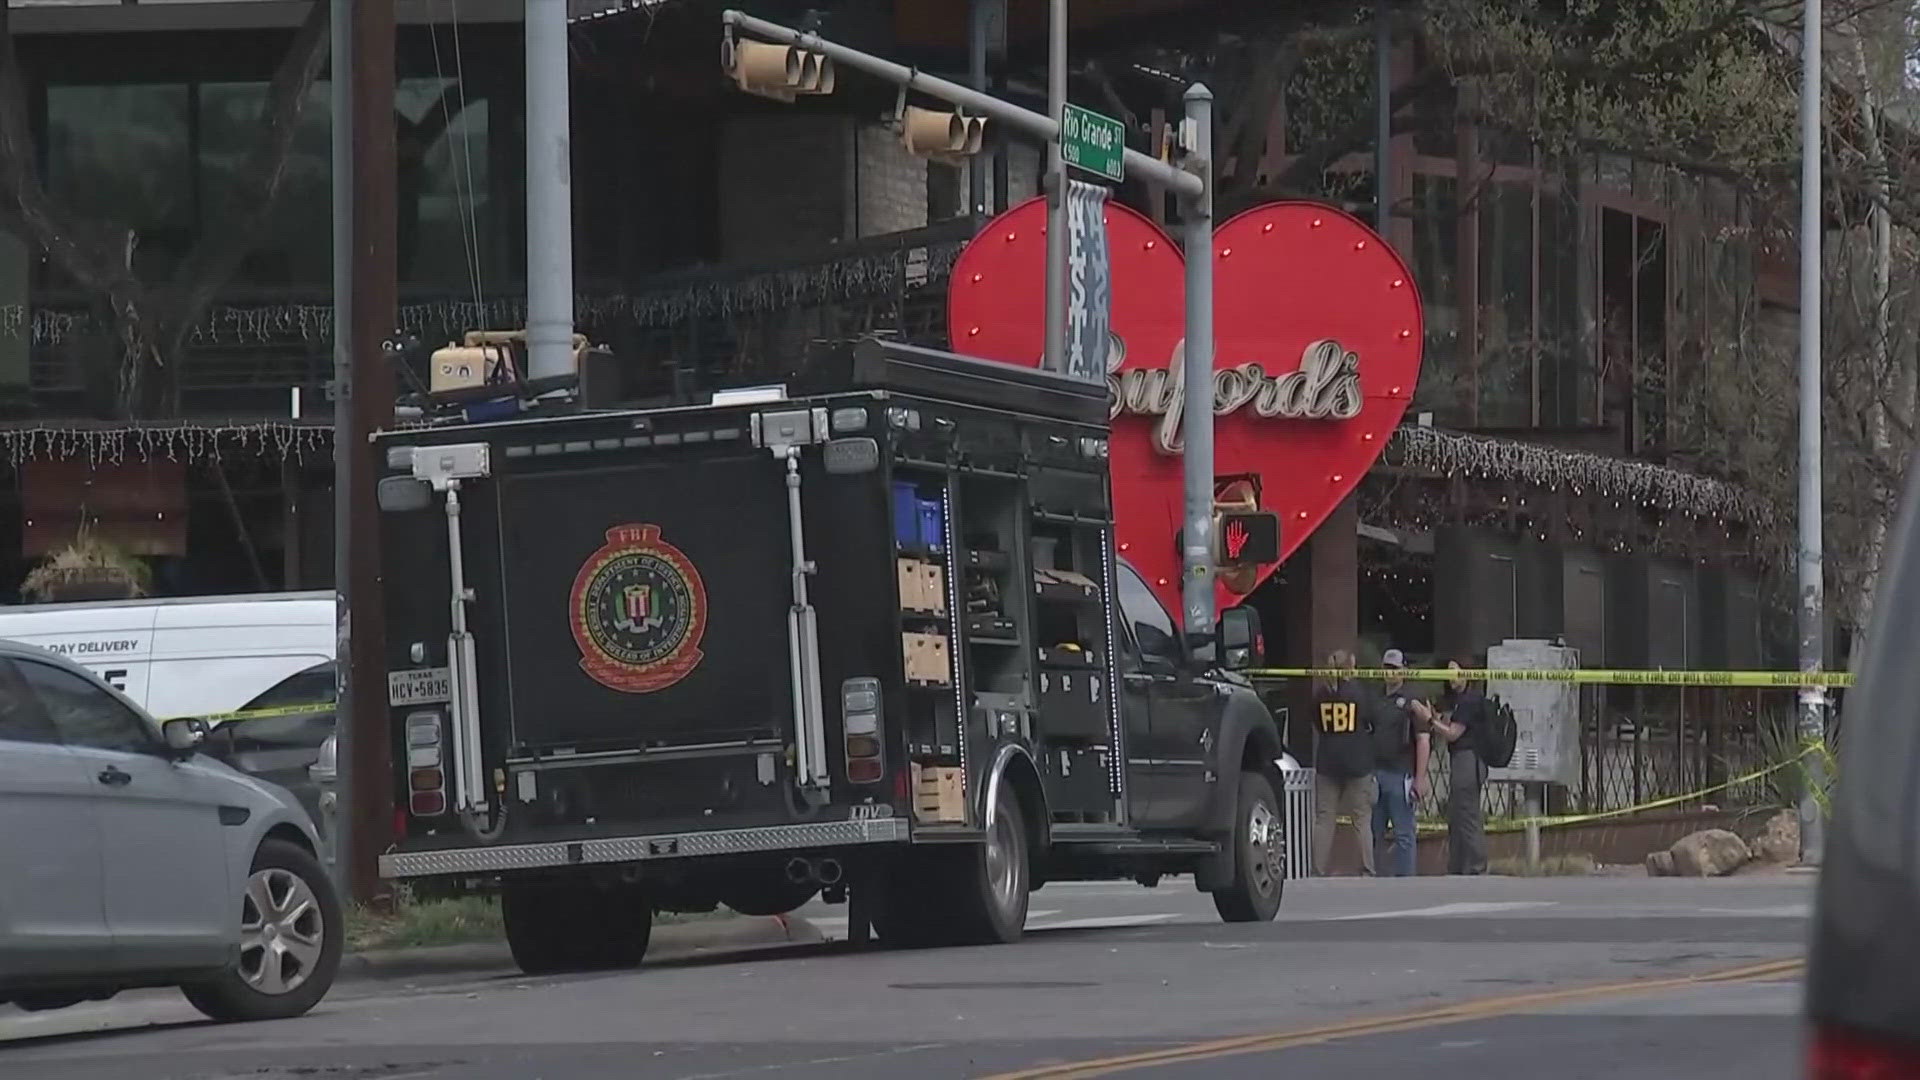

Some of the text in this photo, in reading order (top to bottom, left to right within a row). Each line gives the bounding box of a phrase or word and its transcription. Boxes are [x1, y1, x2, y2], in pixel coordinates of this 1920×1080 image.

[1064, 107, 1079, 139] Rio
[1081, 114, 1113, 151] Grande
[619, 528, 648, 542] FBI
[49, 640, 138, 654] DAY DELIVERY
[408, 672, 432, 680] TEXAS
[1319, 702, 1356, 733] FBI
